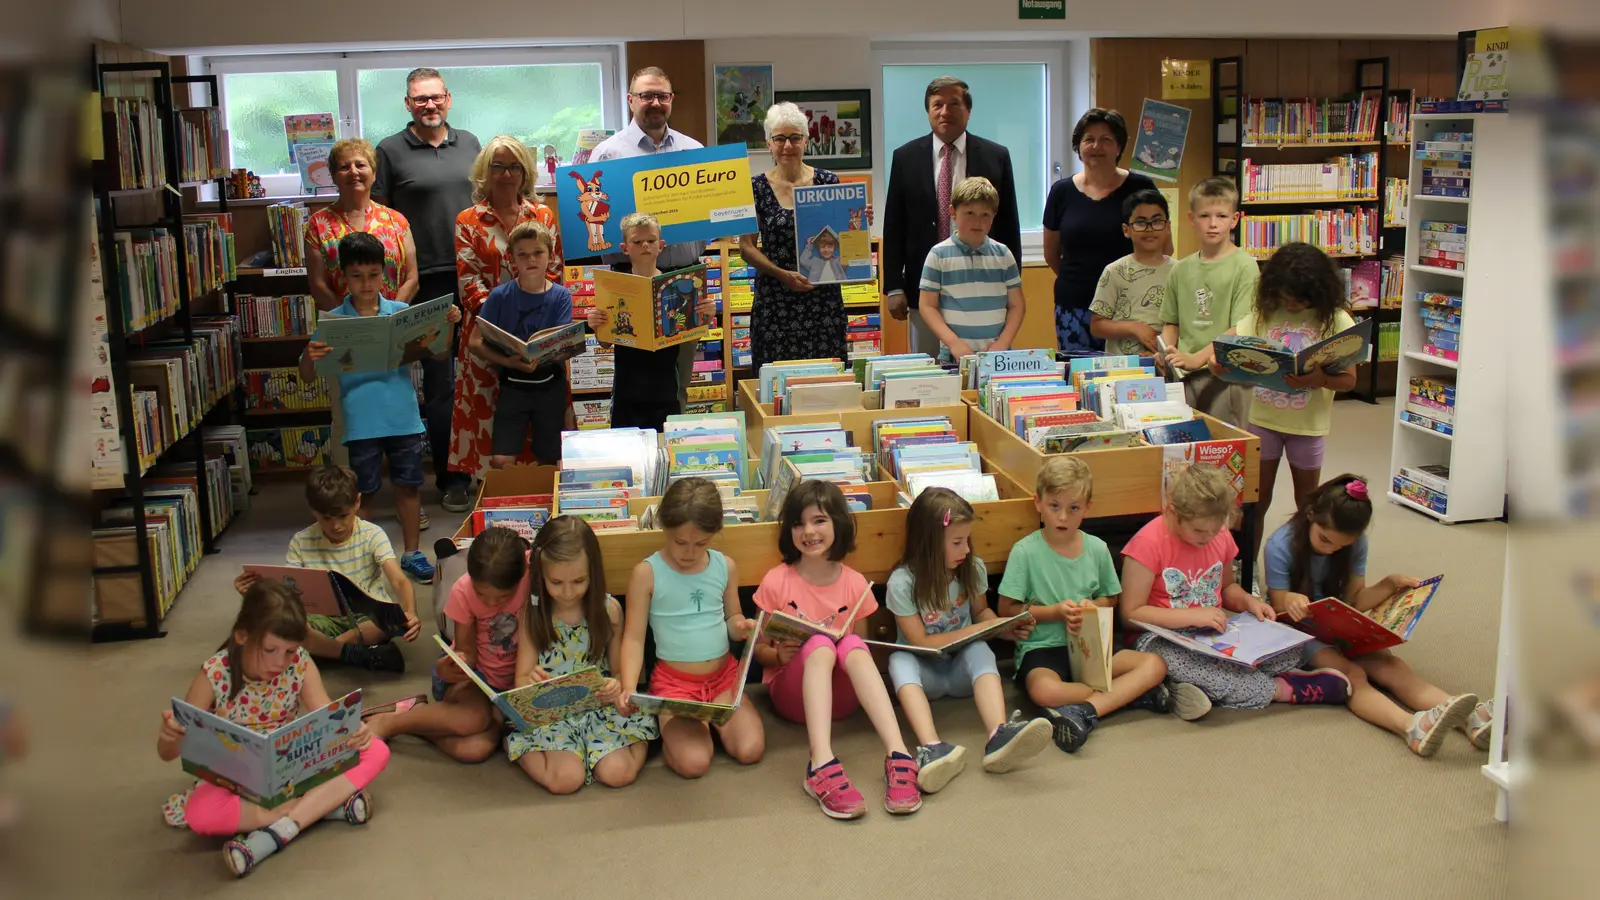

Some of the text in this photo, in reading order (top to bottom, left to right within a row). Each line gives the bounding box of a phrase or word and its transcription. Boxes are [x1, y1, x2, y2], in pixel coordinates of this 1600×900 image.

[1022, 0, 1062, 9] Notausgang
[1242, 129, 1247, 138] A
[1307, 129, 1312, 138] B
[1398, 128, 1403, 136] K
[641, 169, 737, 192] 1.000 Euro
[796, 186, 864, 203] URKUNDE
[1366, 240, 1371, 249] D
[414, 302, 449, 320] BRUMM
[994, 354, 1041, 371] Bienen
[1200, 444, 1233, 455] Wieso?
[286, 737, 323, 762] BUNT
